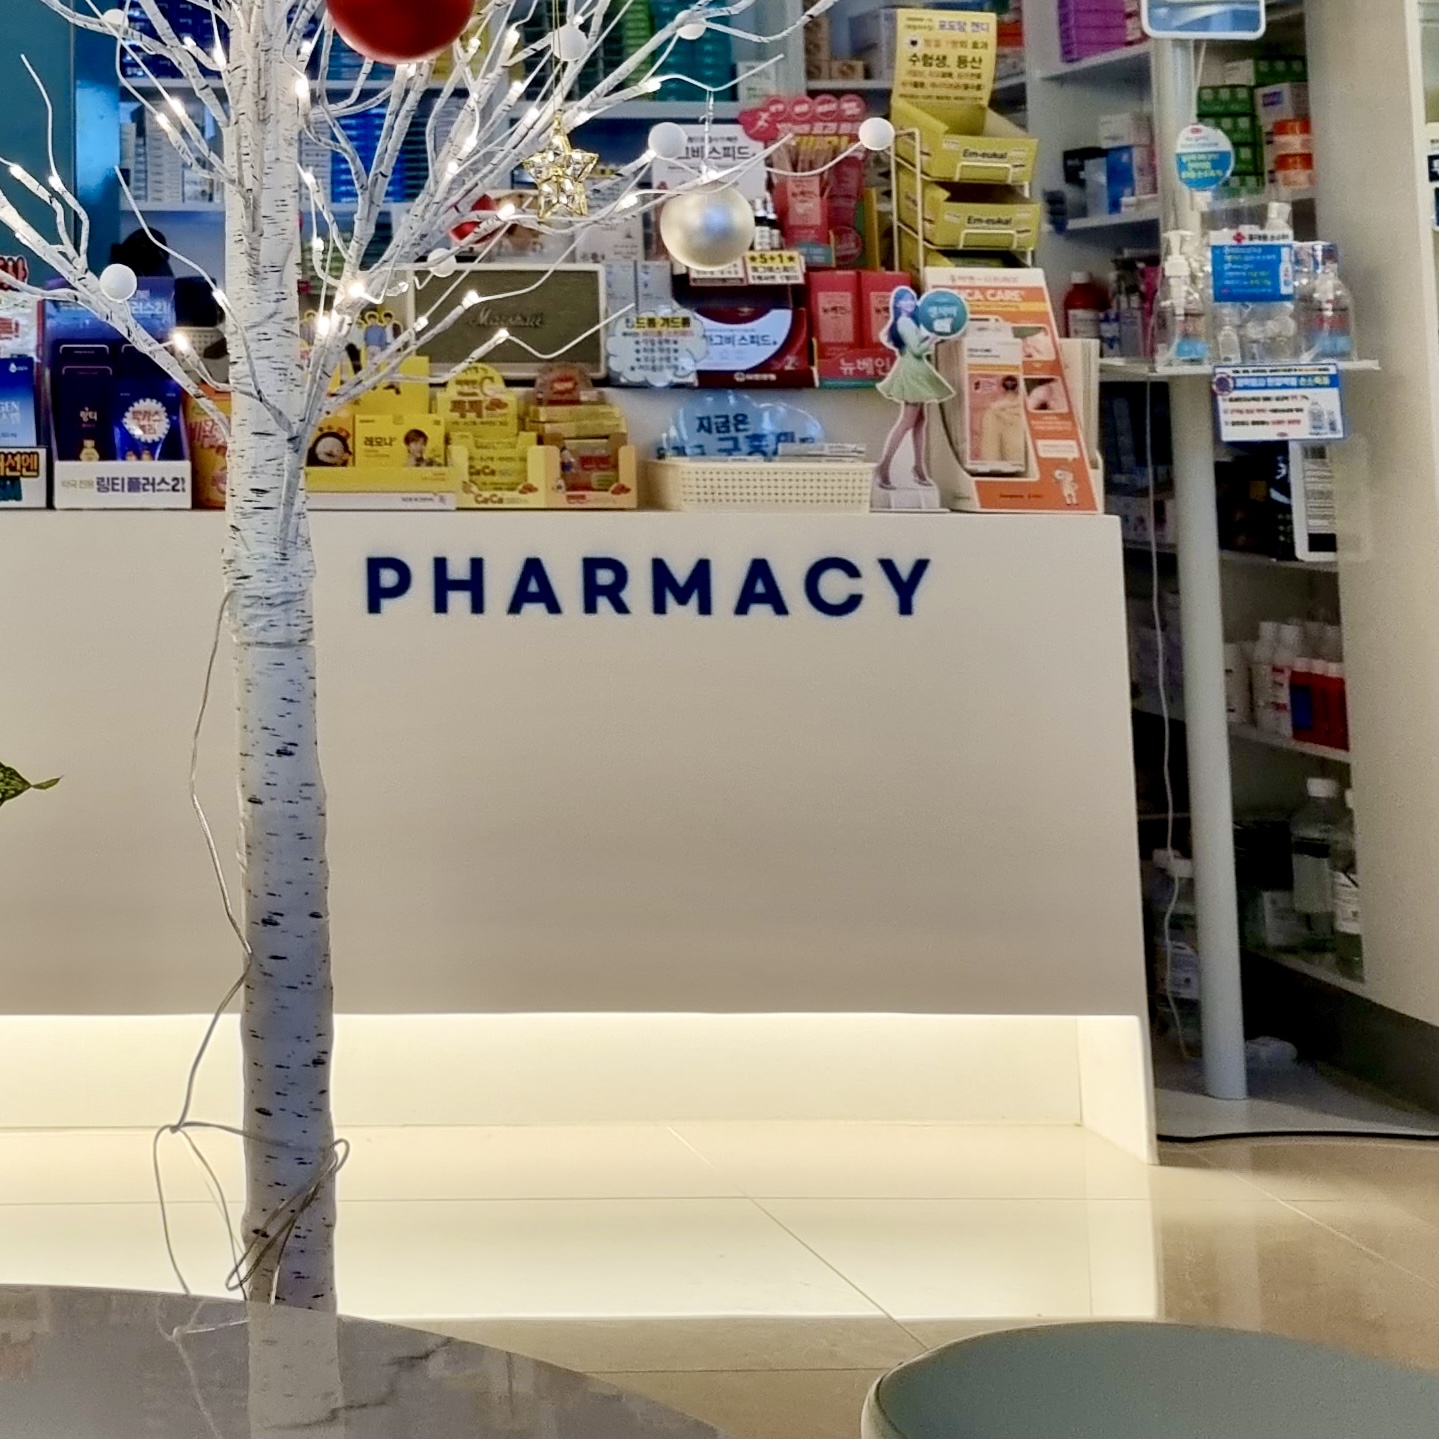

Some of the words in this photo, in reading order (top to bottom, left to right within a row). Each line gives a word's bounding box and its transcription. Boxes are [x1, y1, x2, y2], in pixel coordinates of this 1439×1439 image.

[695, 413, 750, 434] 지금은
[96, 476, 186, 493] 링티플러스21
[366, 555, 932, 617] PHARMACY
